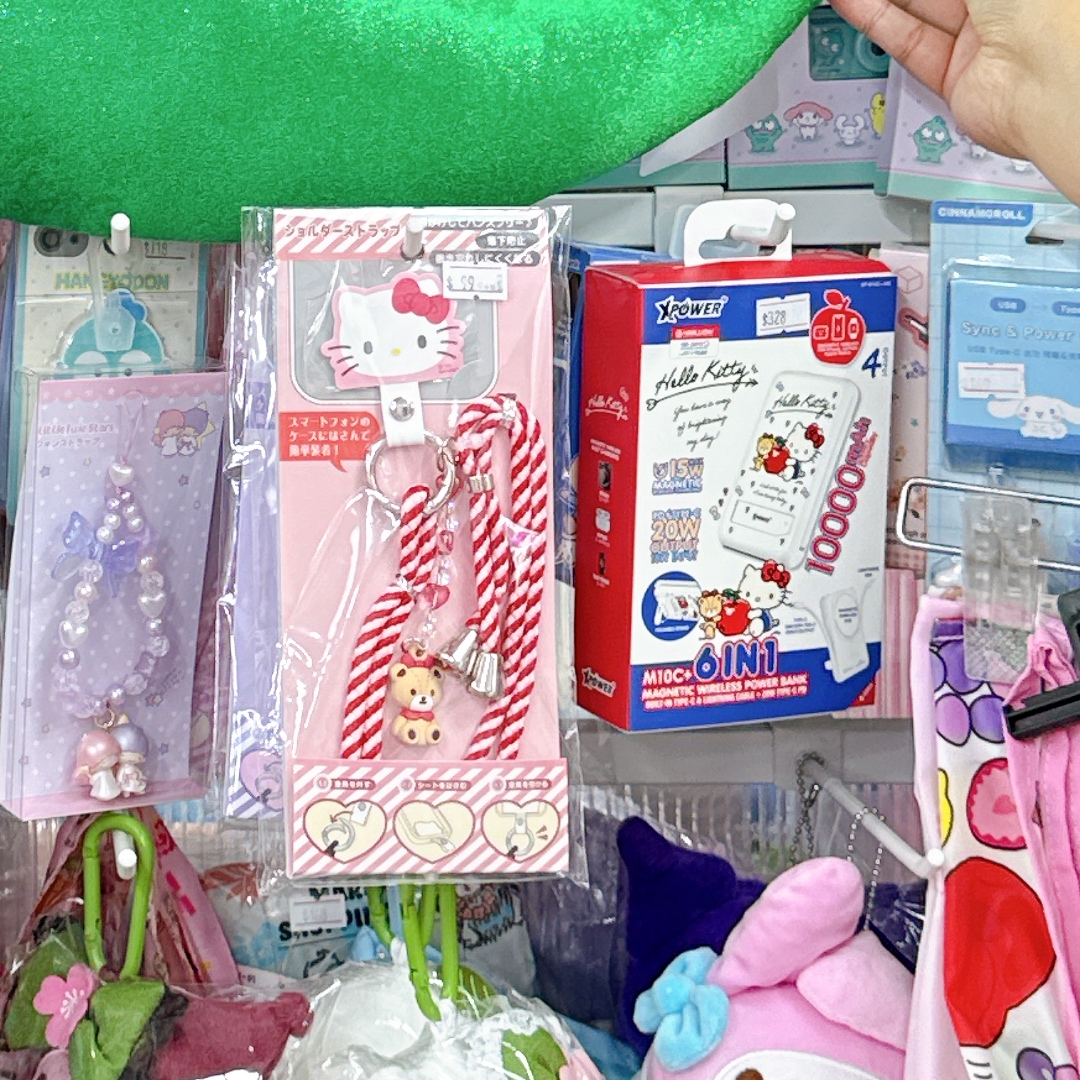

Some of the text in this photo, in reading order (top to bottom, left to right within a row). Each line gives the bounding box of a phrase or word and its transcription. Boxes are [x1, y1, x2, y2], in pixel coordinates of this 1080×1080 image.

[284, 224, 401, 238] ショルダーストラップ
[961, 322, 1074, 342] Sync & Power
[655, 360, 750, 396] Hello Kitty
[288, 416, 371, 428] スマートフォンの
[651, 519, 702, 541] 20W
